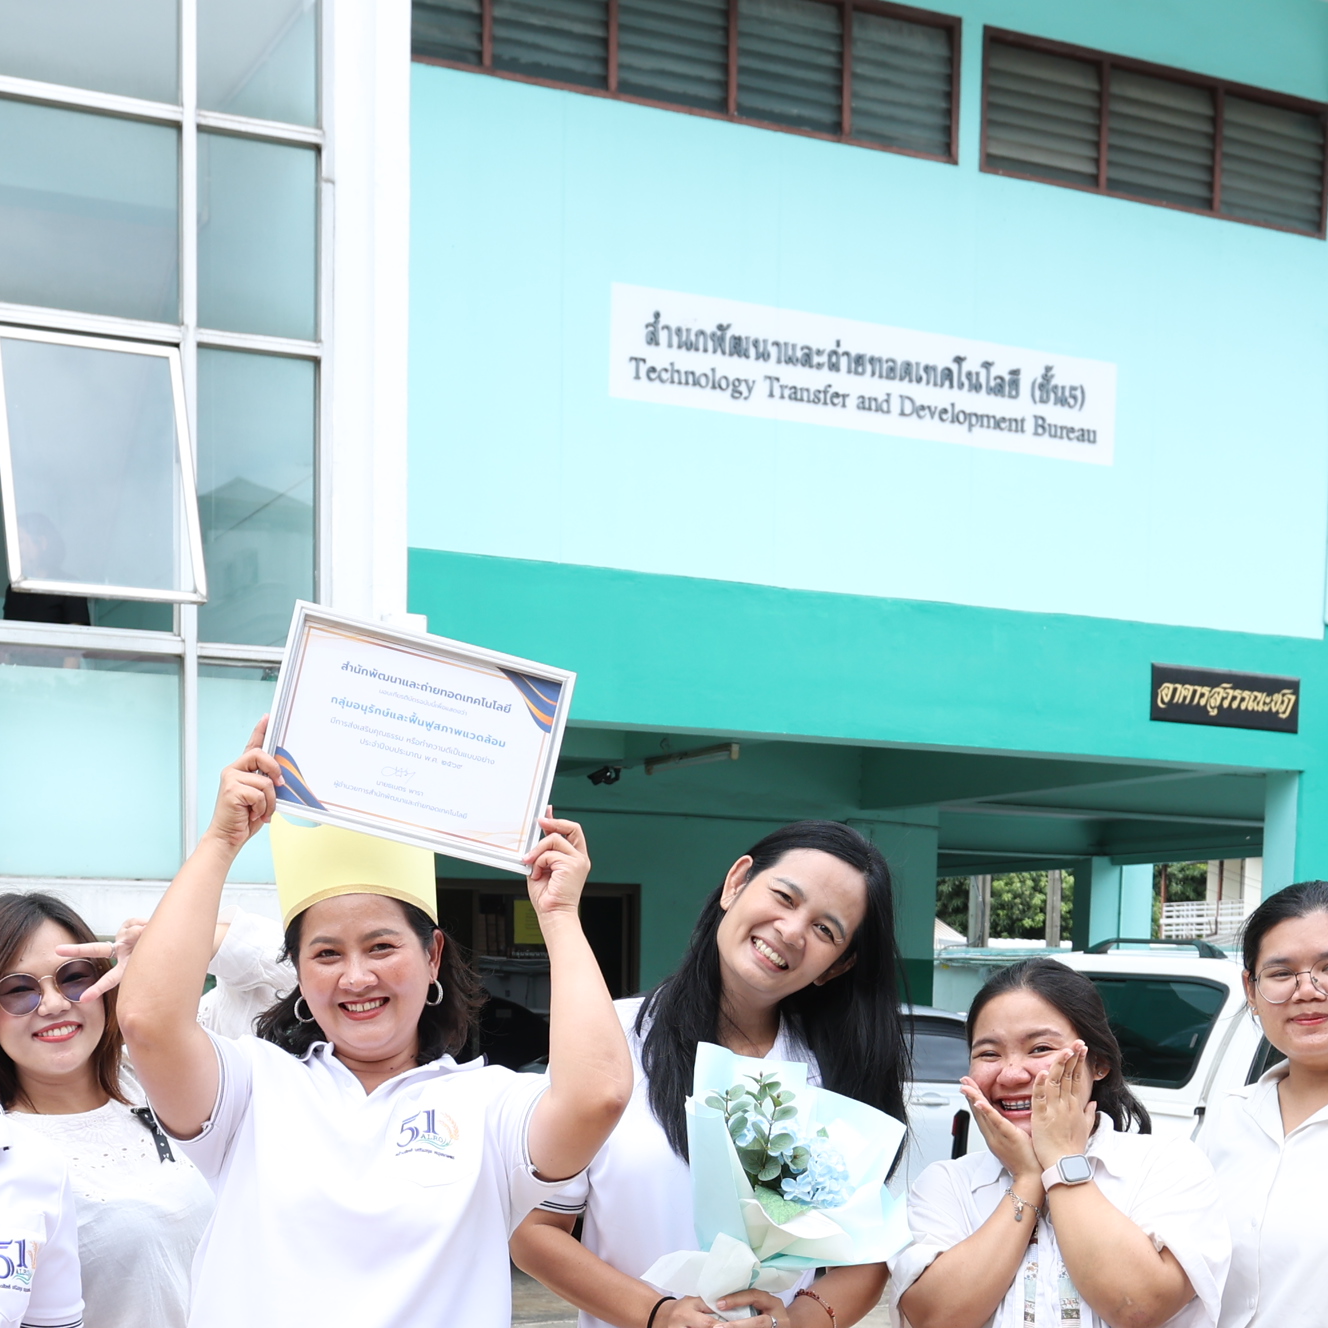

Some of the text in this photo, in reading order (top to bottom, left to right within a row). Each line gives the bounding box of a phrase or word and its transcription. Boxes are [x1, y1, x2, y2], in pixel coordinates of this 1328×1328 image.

[628, 356, 1097, 444] Technology Transfer and Development Bureau
[1030, 365, 1086, 411] (ชั้น5)
[340, 660, 512, 714] สำนักพัฒนาและถ่ายทอดเทคโนโลยี
[329, 716, 496, 765] มีการส่งเสริมคุณธรรม หรือทำความดีเป็นแบบอย่าง
[330, 695, 506, 748] กลุ่มอนุรักษ์และฟื้นฟูสภาพแวดล้อม
[359, 738, 423, 760] ประจำปีงบประมาณ
[396, 1108, 439, 1148] 51
